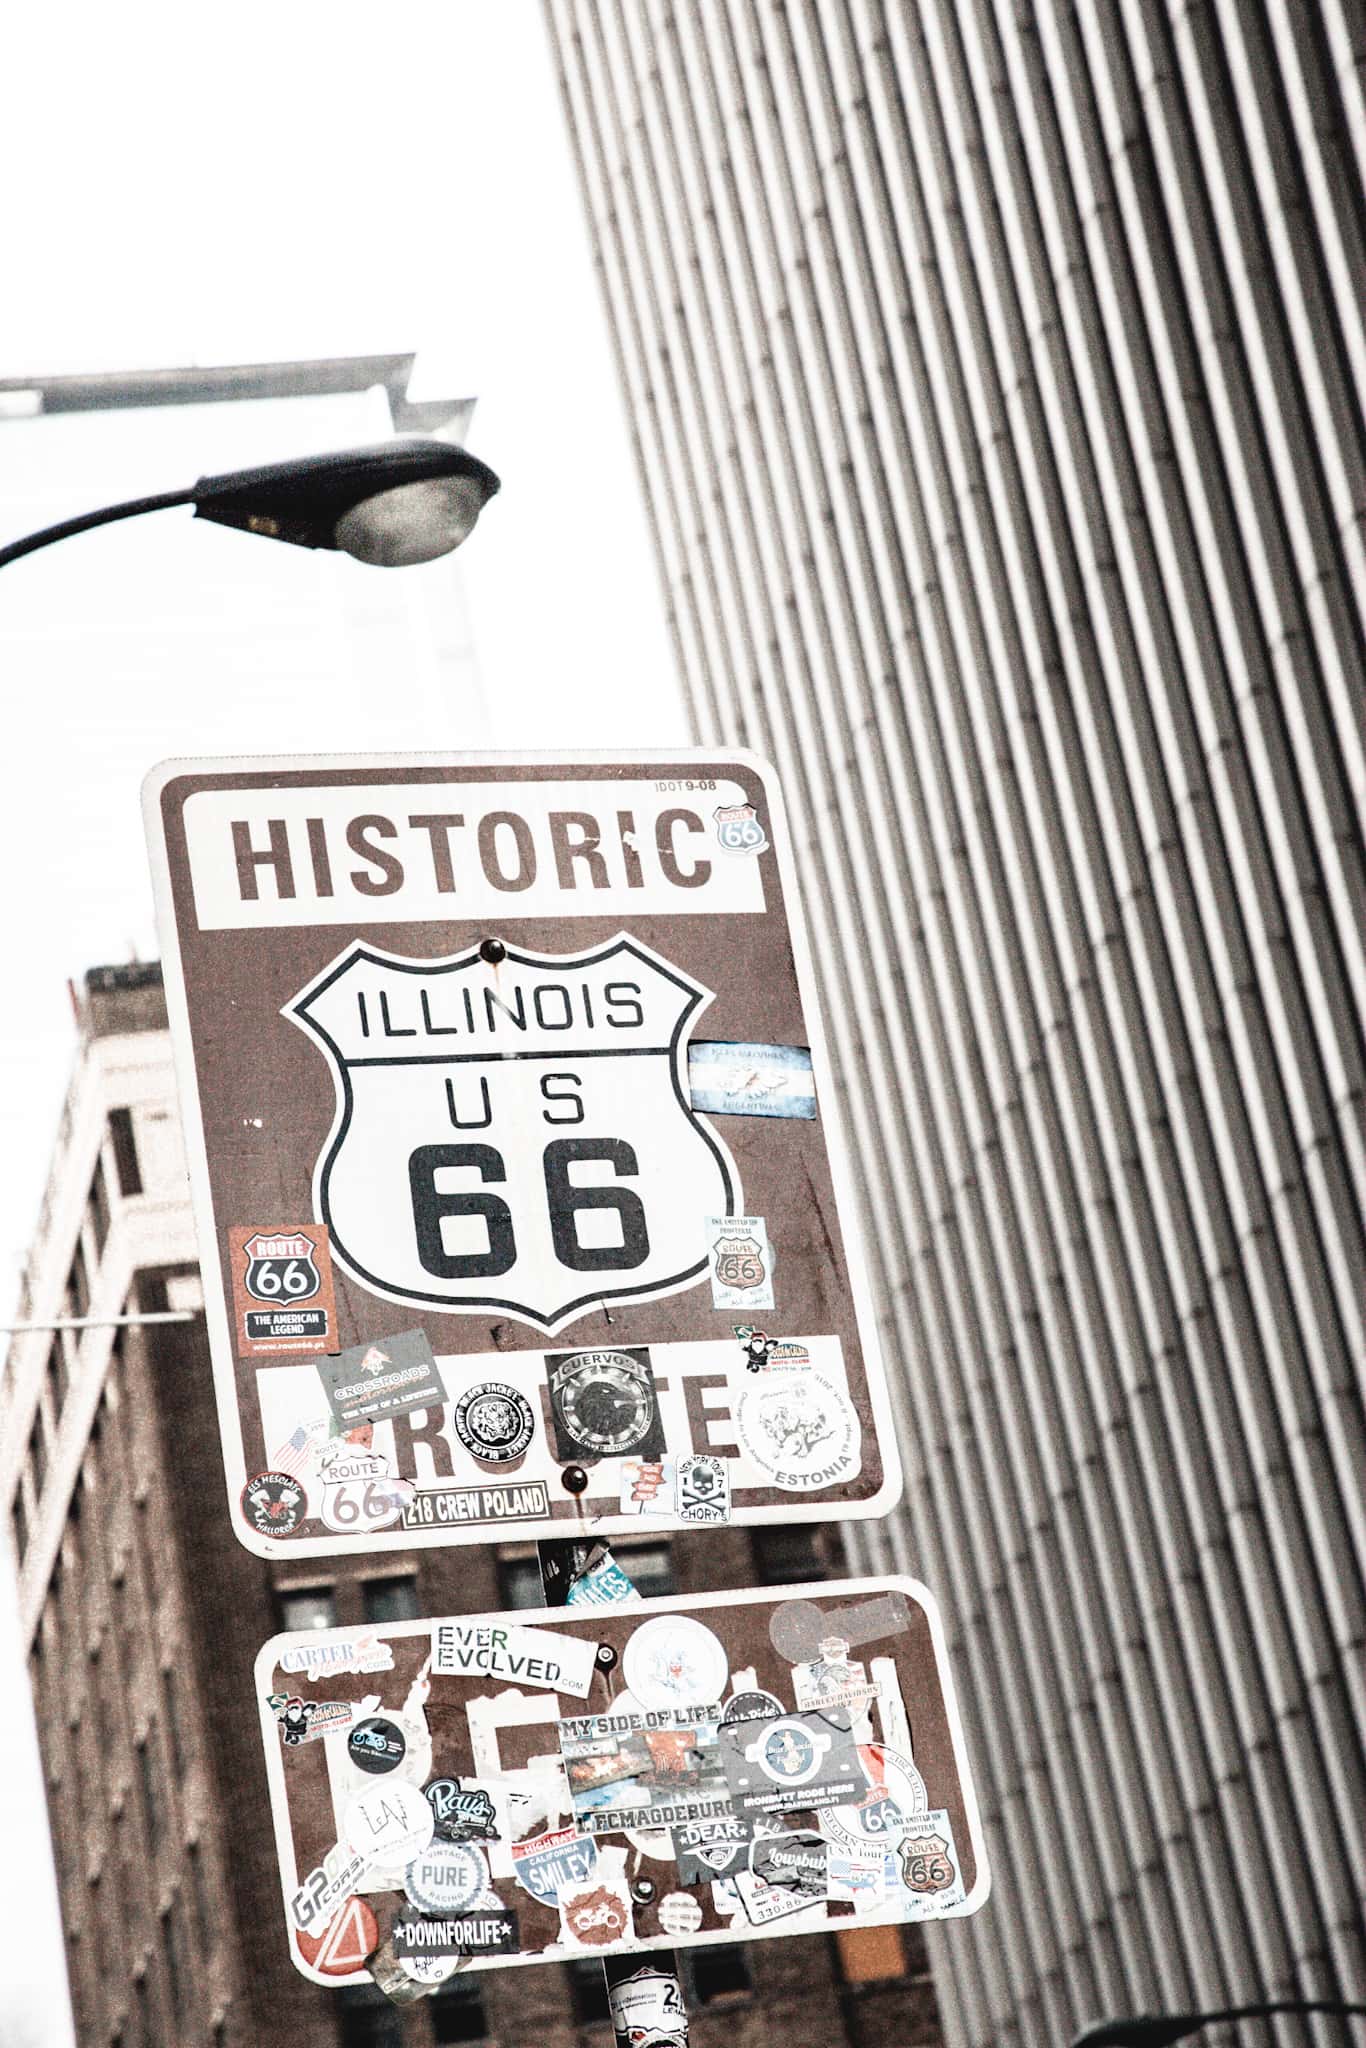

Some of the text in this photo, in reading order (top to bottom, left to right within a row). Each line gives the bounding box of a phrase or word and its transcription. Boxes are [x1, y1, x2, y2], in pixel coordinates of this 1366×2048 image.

[685, 781, 717, 791] 9-08
[726, 821, 760, 847] 66
[230, 808, 713, 901] HISTORIC
[357, 982, 644, 1038] ILLINOIS
[408, 1137, 651, 1279] 66
[256, 1240, 304, 1257] ROUTE
[256, 1259, 308, 1295] 66
[724, 1256, 756, 1279] 66
[253, 1313, 320, 1326] THE AMERICAN
[270, 1324, 305, 1336] LEGEND
[561, 1353, 636, 1376] CUERVOS
[334, 1364, 431, 1401] CROSSROADS
[328, 1461, 379, 1480] ROUTE
[774, 1455, 853, 1487] ESTONIA
[332, 1482, 392, 1524] 66
[407, 1487, 545, 1524] 218 CREW POLAND
[680, 1507, 728, 1521] CHORY'S
[438, 1626, 509, 1651] EVER
[283, 1643, 354, 1670] CARTER
[438, 1647, 561, 1682] EVOLVED
[562, 1719, 593, 1738] MY
[597, 1714, 642, 1734] SIDE
[645, 1710, 670, 1729] OF
[673, 1704, 720, 1725] LIFE
[427, 1781, 491, 1820] Ray's
[743, 1783, 856, 1808] IRONBUTT RODE HERE
[523, 1831, 575, 1855] HIGHWAY
[686, 1823, 740, 1845] DEAR
[427, 1850, 467, 1862] VINTAGE
[529, 1844, 580, 1866] CALIFORNIA
[906, 1842, 940, 1855] ROUTE
[421, 1865, 468, 1887] PURE
[529, 1850, 593, 1896] SMILEY
[911, 1858, 946, 1884] 66
[405, 1919, 502, 1947] DOWNFORLIFE
